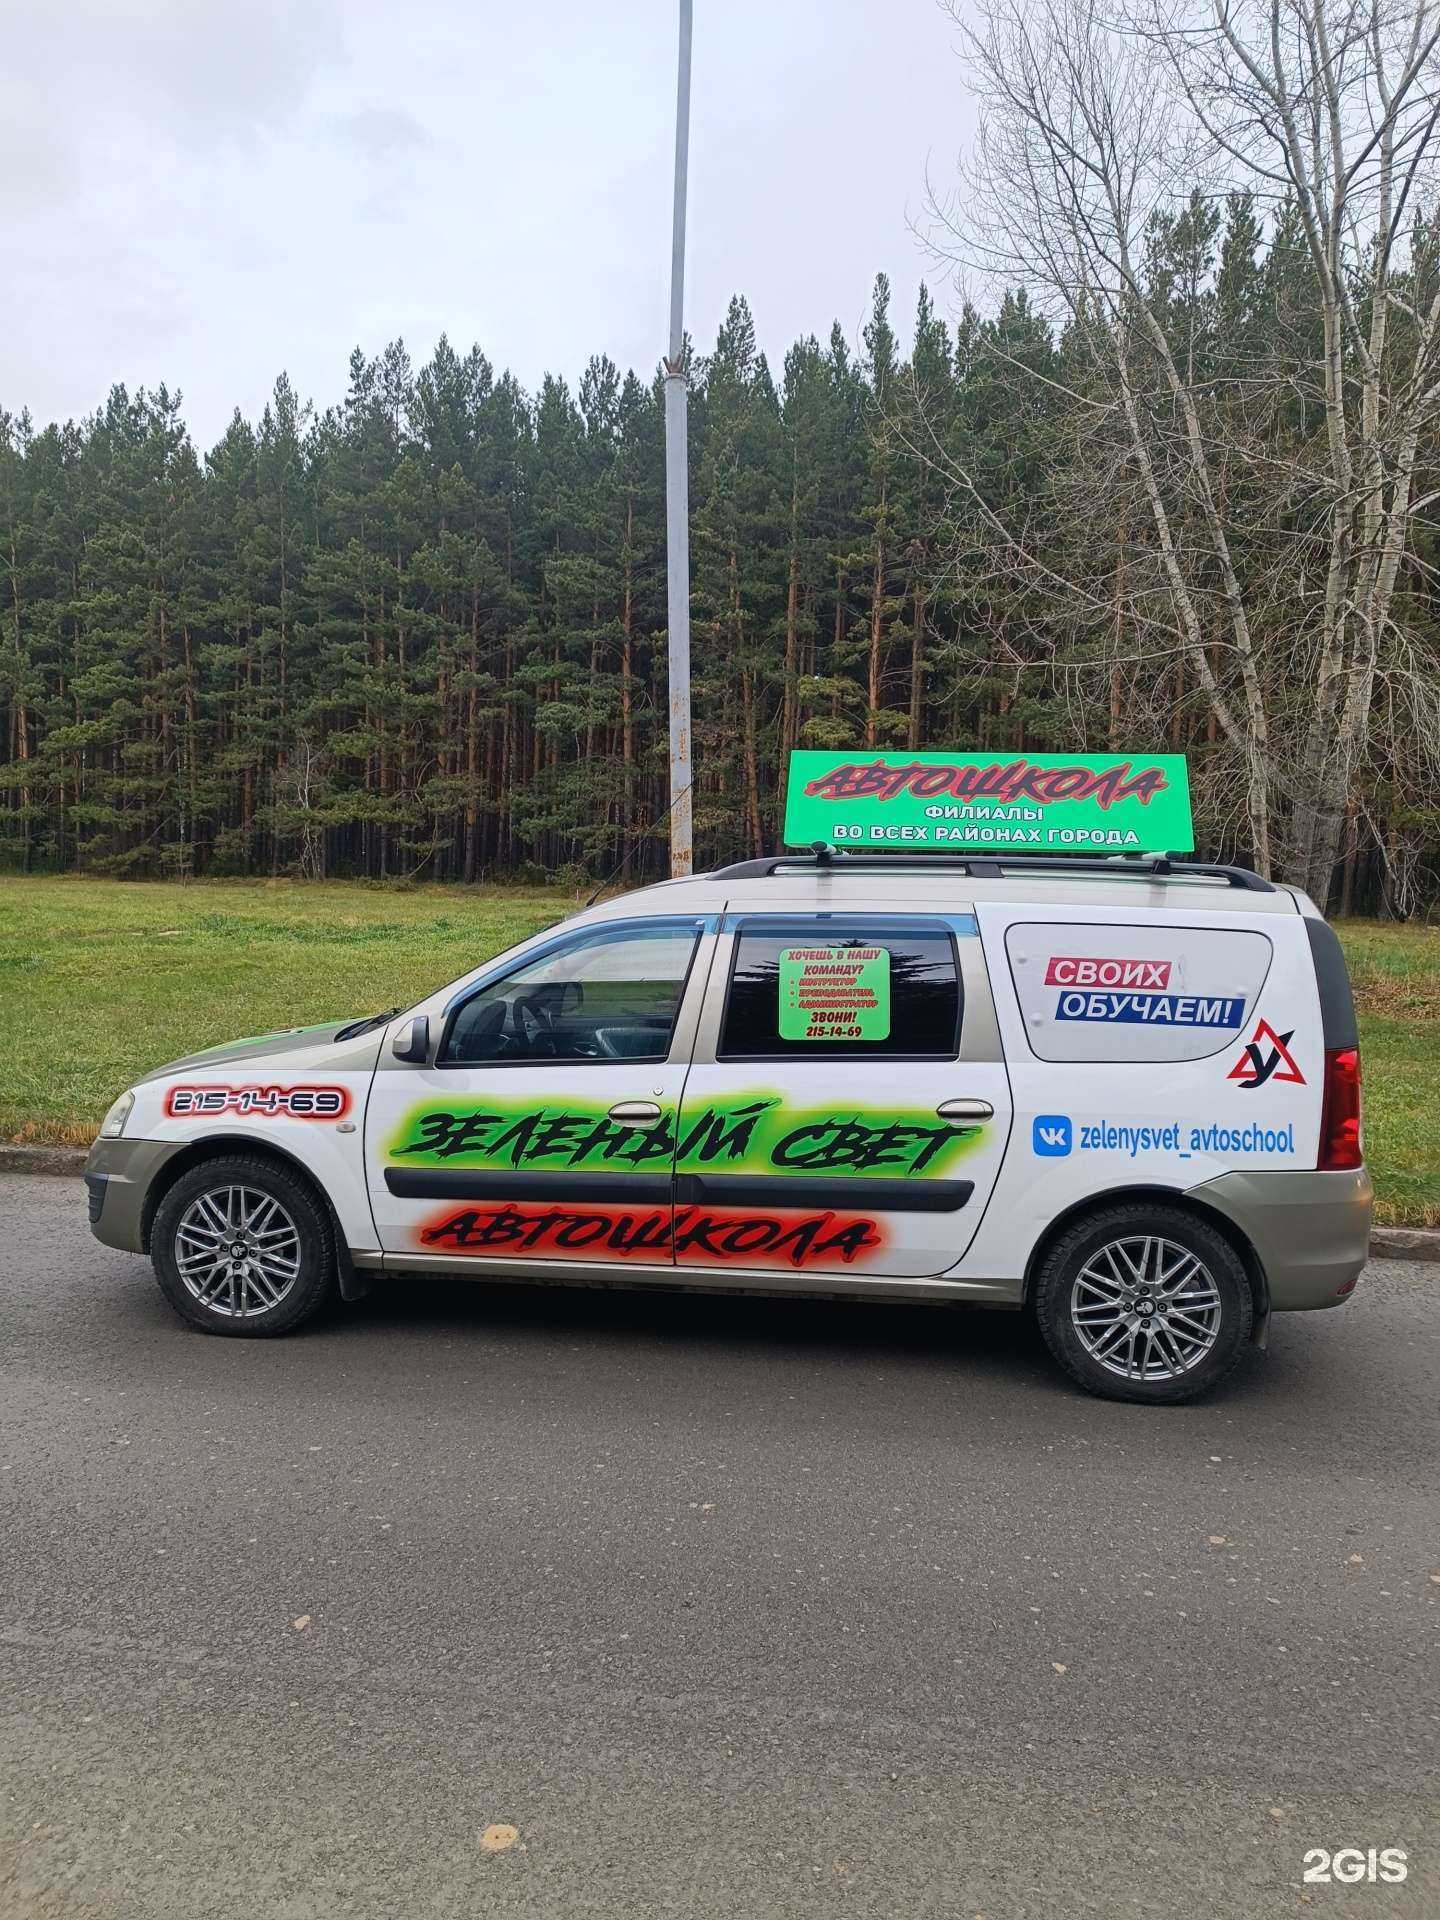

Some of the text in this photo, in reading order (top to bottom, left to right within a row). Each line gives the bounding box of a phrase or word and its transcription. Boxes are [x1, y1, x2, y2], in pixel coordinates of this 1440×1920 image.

[807, 760, 1169, 808] АВТОШКОЛА
[925, 805, 1044, 821] ФИЛИАЛЫ
[833, 824, 1139, 844] ВО ВСЕХ РАЙОНАХ ГОРОДА
[788, 950, 880, 960] ХОЧЕШЬ В НАШУ
[804, 965, 864, 976] КОМАНДУ?
[1054, 960, 1168, 987] СВОИХ
[811, 1012, 857, 1022] ЗВОНИ!
[1062, 993, 1233, 1024] ОБУЧАЕМ!
[806, 1026, 862, 1037] 215-14-69
[174, 1092, 340, 1112] 215-14-69
[398, 1101, 980, 1175] ЗЕЛЕНЫЙ СВЕТ
[1081, 1120, 1295, 1158] zelenysvet_avtoschool
[423, 1206, 879, 1265] АВТОШКОЛА
